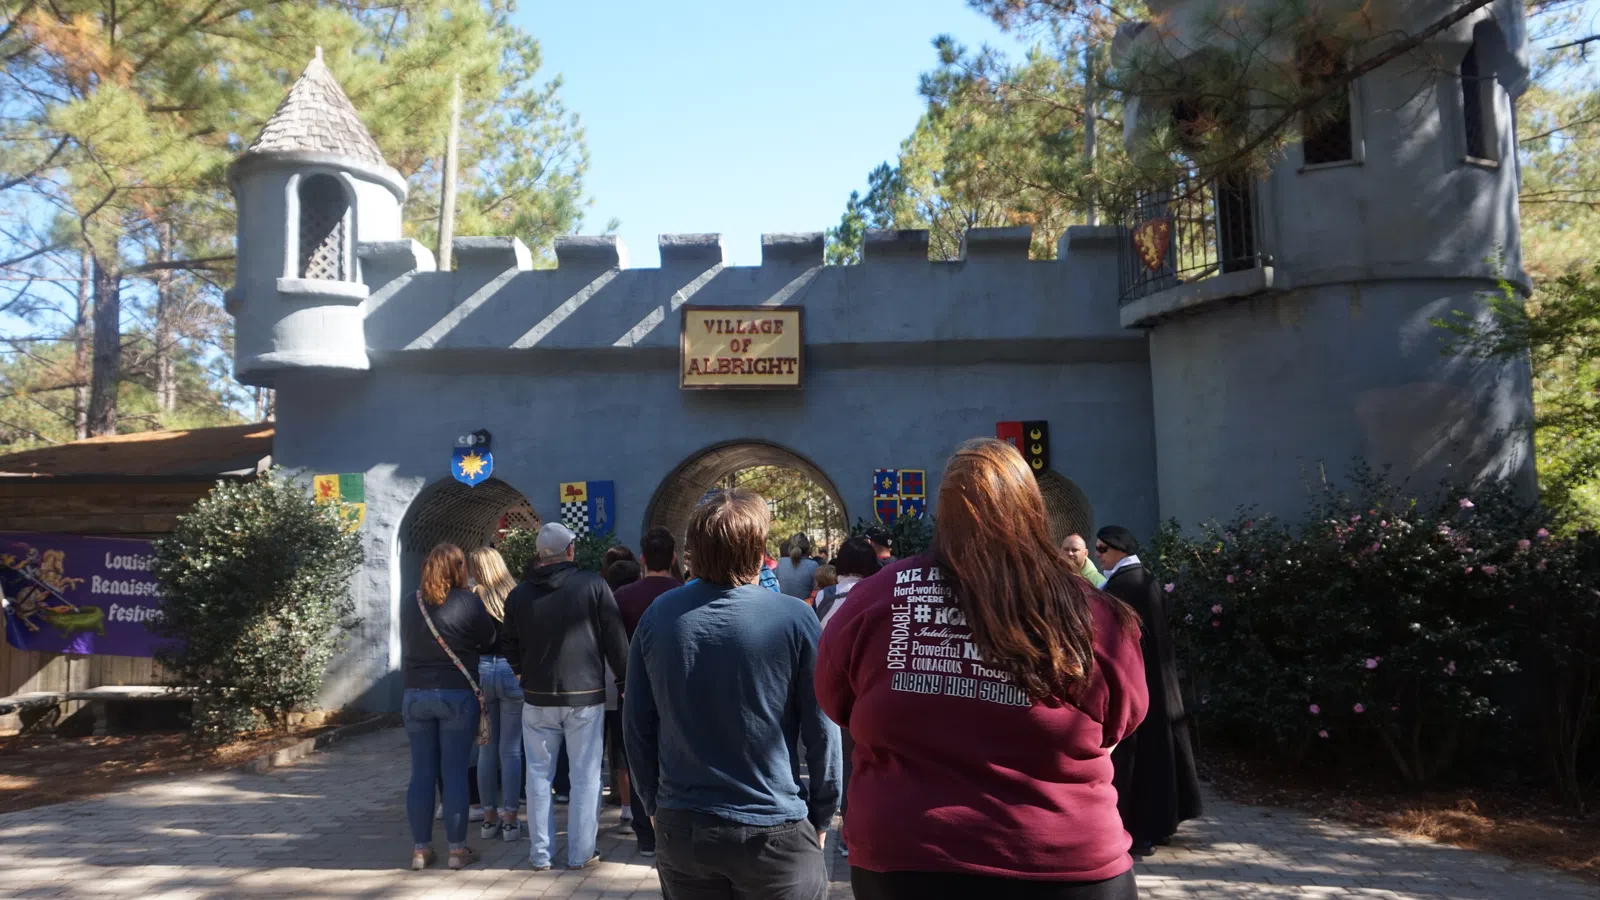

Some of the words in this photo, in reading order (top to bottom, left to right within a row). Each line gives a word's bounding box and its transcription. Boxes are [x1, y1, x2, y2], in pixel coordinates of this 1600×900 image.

[704, 320, 784, 334] VILLAGE
[730, 338, 752, 353] OF
[687, 357, 797, 375] ALBRIGHT
[896, 568, 922, 584] WE
[894, 583, 951, 598] Hard-working
[887, 604, 911, 670] DEPENDABLE
[914, 627, 972, 646] Intelligent
[911, 641, 960, 659] Powerful
[912, 658, 962, 674] COURAGEOUS
[891, 672, 942, 694] ALBANY
[944, 678, 977, 699] HIGH
[979, 681, 1032, 707] SCHOOL
